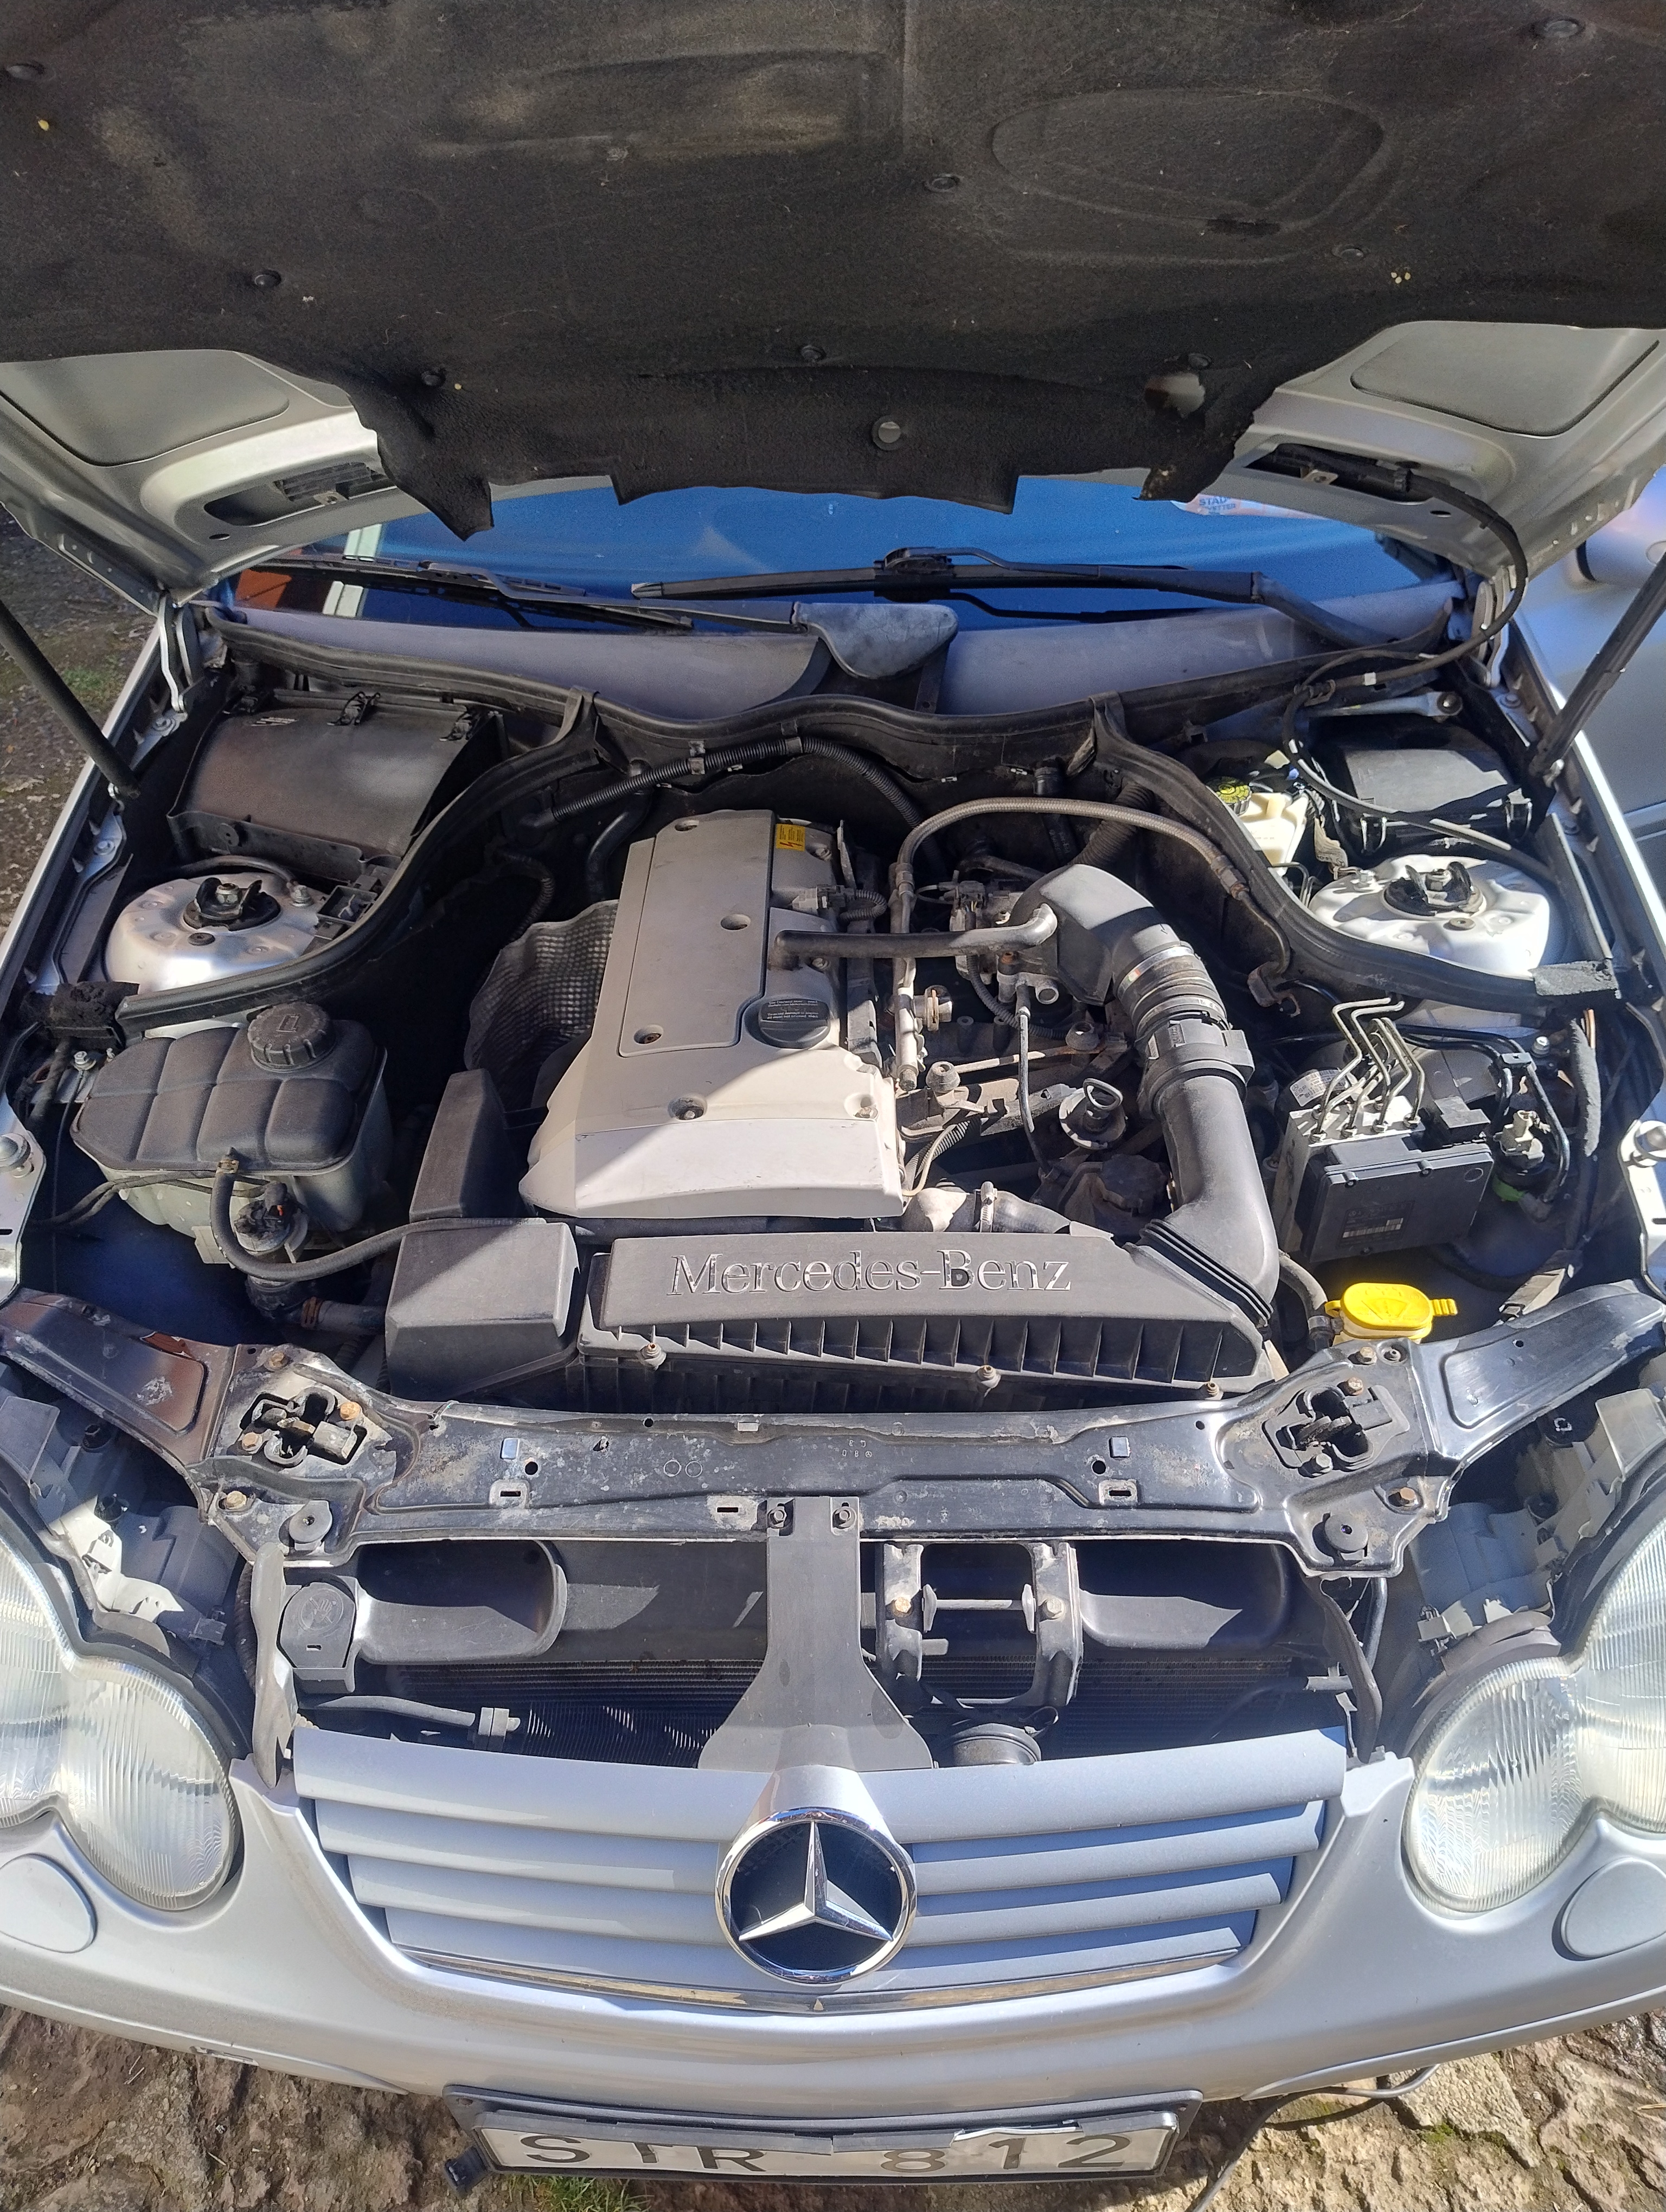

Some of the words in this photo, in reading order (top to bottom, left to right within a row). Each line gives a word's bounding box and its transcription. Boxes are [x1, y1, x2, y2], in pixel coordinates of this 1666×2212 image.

[1295, 1085, 1306, 1096] ESP
[667, 1249, 1071, 1296] Mercedes-Benz
[880, 2134, 1131, 2173] 812
